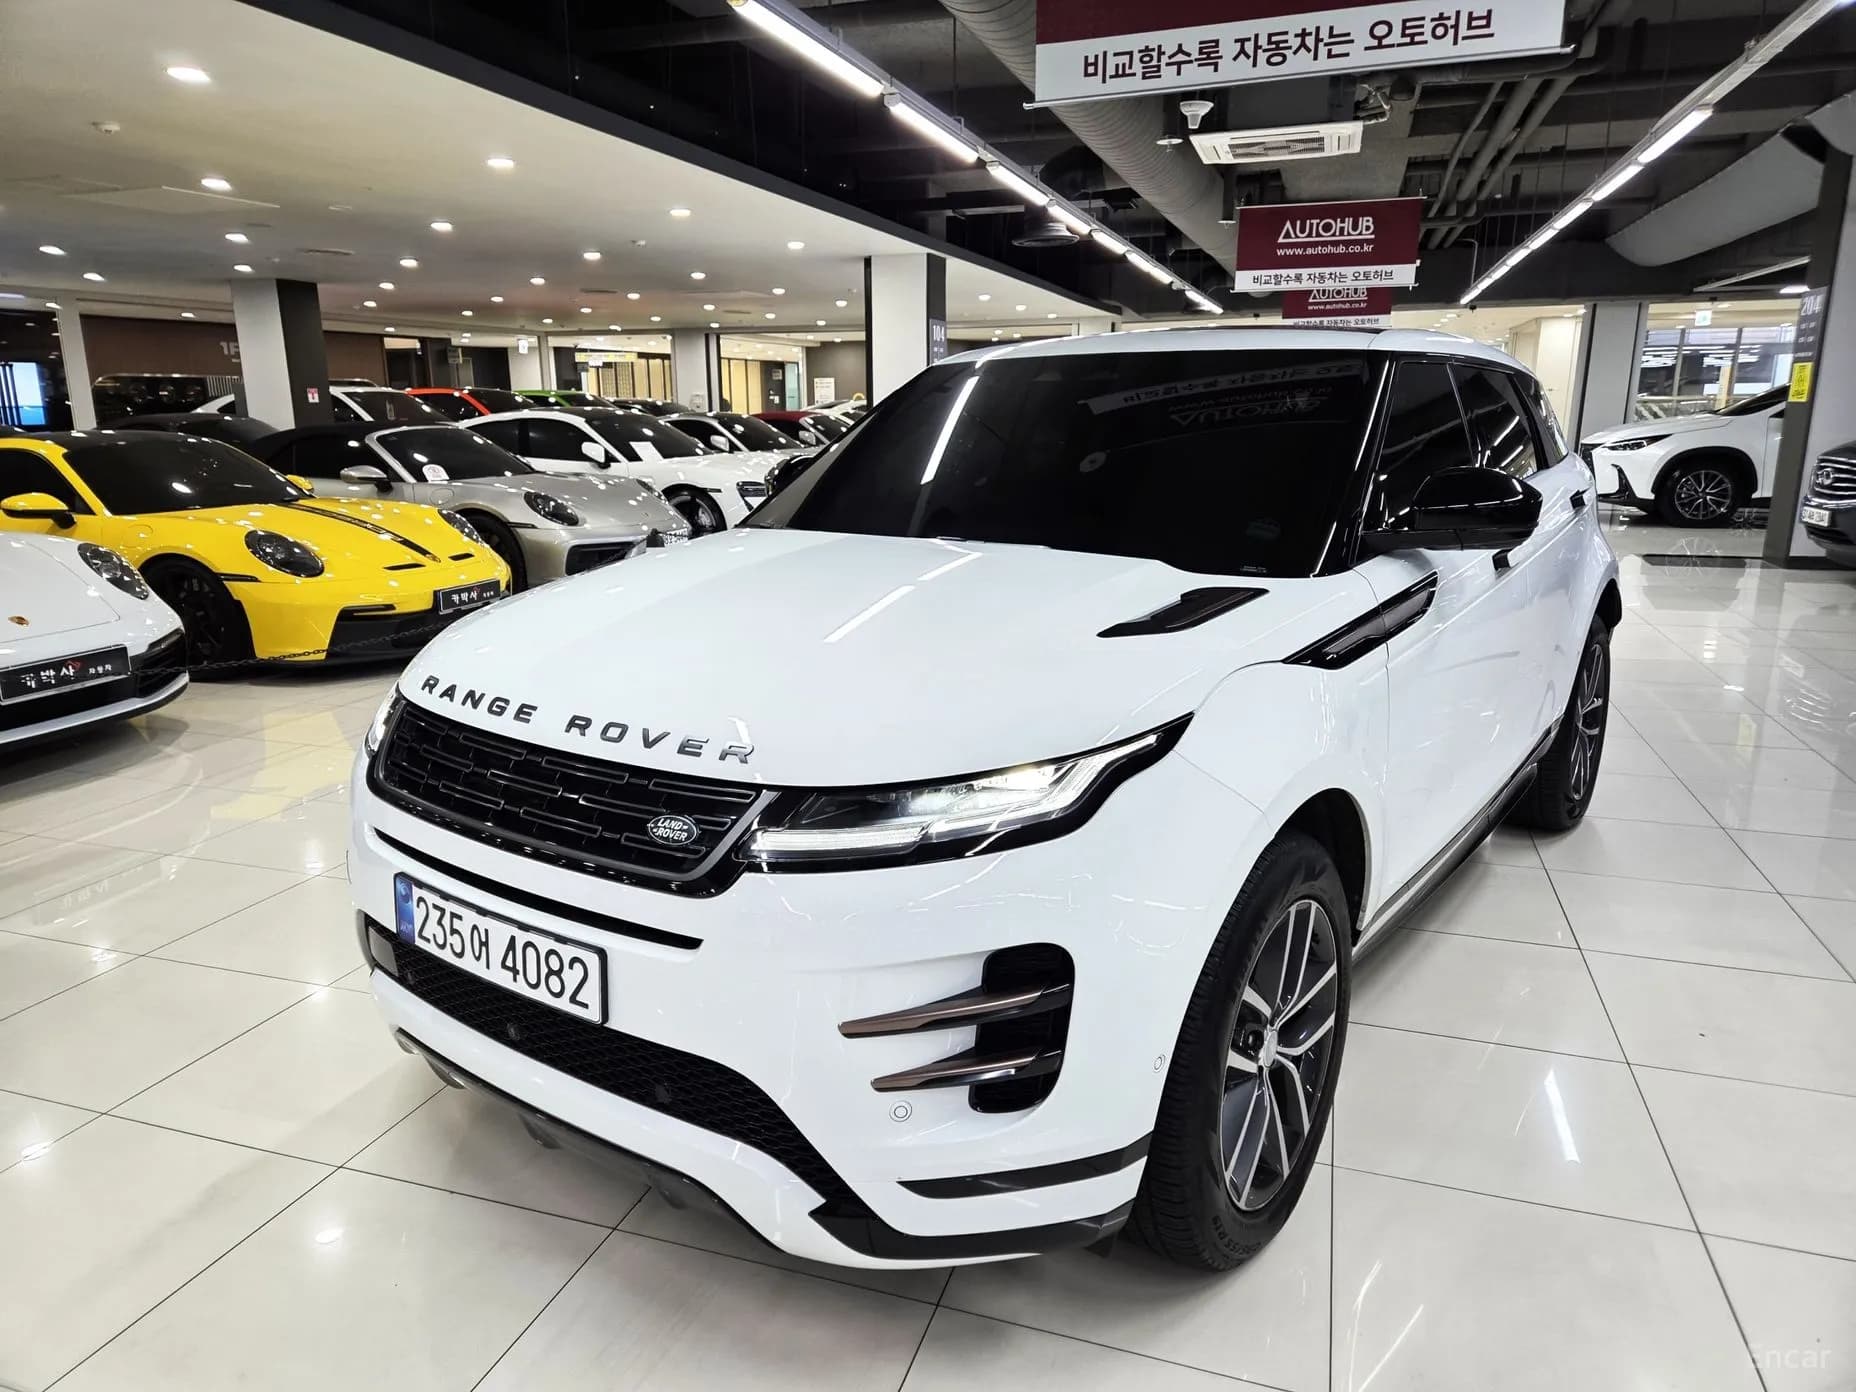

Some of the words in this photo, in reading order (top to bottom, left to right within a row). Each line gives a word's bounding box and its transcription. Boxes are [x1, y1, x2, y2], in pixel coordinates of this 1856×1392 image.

[1083, 38, 1223, 84] 비교할수록
[1232, 25, 1355, 68] 자동차는
[1364, 8, 1495, 51] 오토허브
[1277, 216, 1375, 243] AUTOHUB
[1276, 243, 1374, 257] www.autohub.co.kr
[1252, 271, 1304, 287] 비교할수록
[1306, 270, 1348, 285] 자동차는
[1351, 269, 1394, 282] 오토허브
[1308, 287, 1368, 302] AUTOHUB
[1800, 294, 1824, 316] 204
[932, 325, 945, 342] 104
[421, 674, 539, 724] RANGE
[564, 714, 755, 765] ROVER
[416, 896, 490, 970] 235어
[501, 934, 590, 1010] 4082
